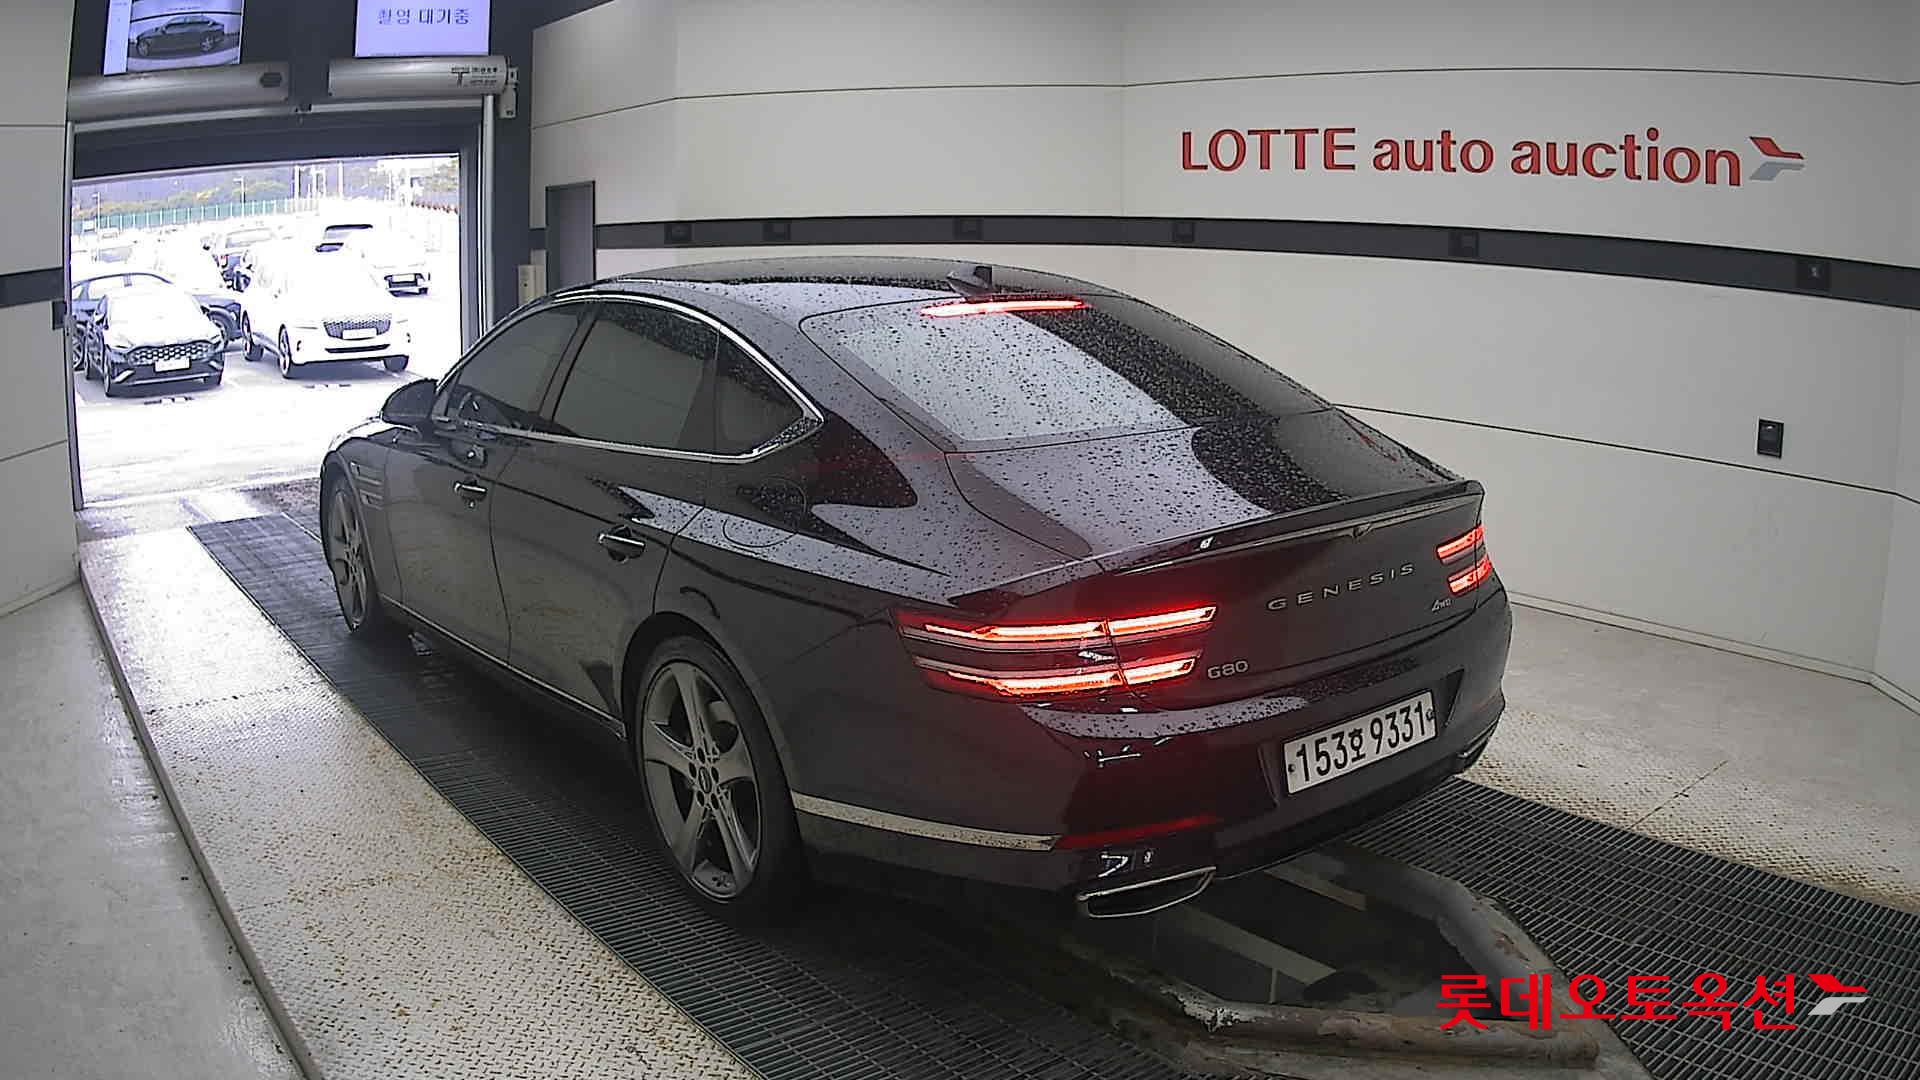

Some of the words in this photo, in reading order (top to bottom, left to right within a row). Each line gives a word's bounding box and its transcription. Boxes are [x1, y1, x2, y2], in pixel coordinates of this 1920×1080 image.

[419, 8, 471, 25] 대기중
[1181, 127, 1356, 172] LOTTE
[1372, 129, 1494, 173] auto
[1511, 127, 1741, 186] auction
[1267, 563, 1415, 611] GENESIS
[1207, 659, 1249, 680] G80
[1370, 701, 1425, 755] 9331
